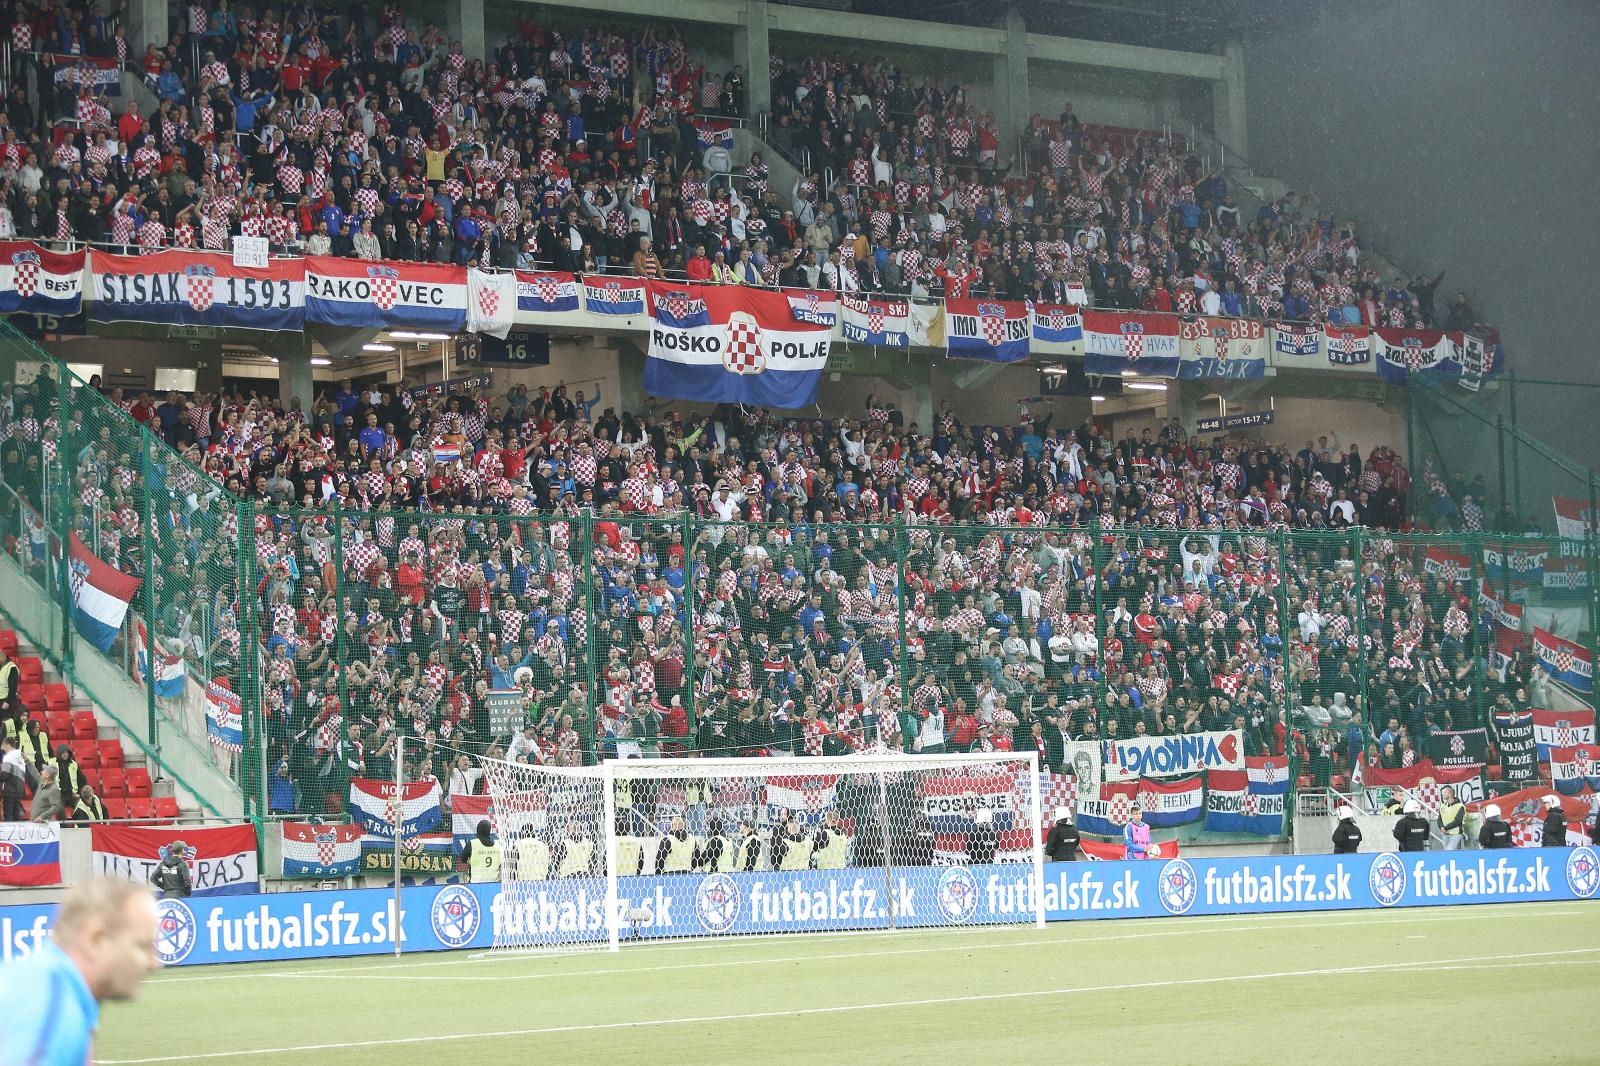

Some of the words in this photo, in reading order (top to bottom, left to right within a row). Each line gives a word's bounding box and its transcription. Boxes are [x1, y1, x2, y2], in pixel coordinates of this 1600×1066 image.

[44, 278, 78, 293] BEST
[102, 271, 181, 306] SISAK
[227, 277, 292, 311] 1593
[952, 315, 977, 337] IMO
[1231, 319, 1260, 339] BBB
[653, 329, 721, 354] ROŠKO
[770, 341, 828, 359] POLJE
[885, 332, 902, 346] NIK
[1147, 337, 1175, 351] HVAR
[461, 343, 477, 361] 16
[505, 343, 527, 360] 16
[1330, 352, 1367, 363] STARI
[1195, 360, 1250, 379] SISAK
[1046, 375, 1062, 390] 17
[1242, 415, 1261, 425] 15-17
[1443, 755, 1475, 764] POSUŠJE
[1163, 792, 1192, 808] HEIM
[1259, 796, 1282, 814] BRIG
[196, 853, 247, 889] RAS
[366, 852, 453, 872] SUKOŠAN
[485, 856, 493, 868] 9
[1204, 863, 1353, 905] futbalsfz.sk
[1413, 856, 1551, 897] futbalsfz.sk
[207, 898, 408, 953] futbalsfz.sk
